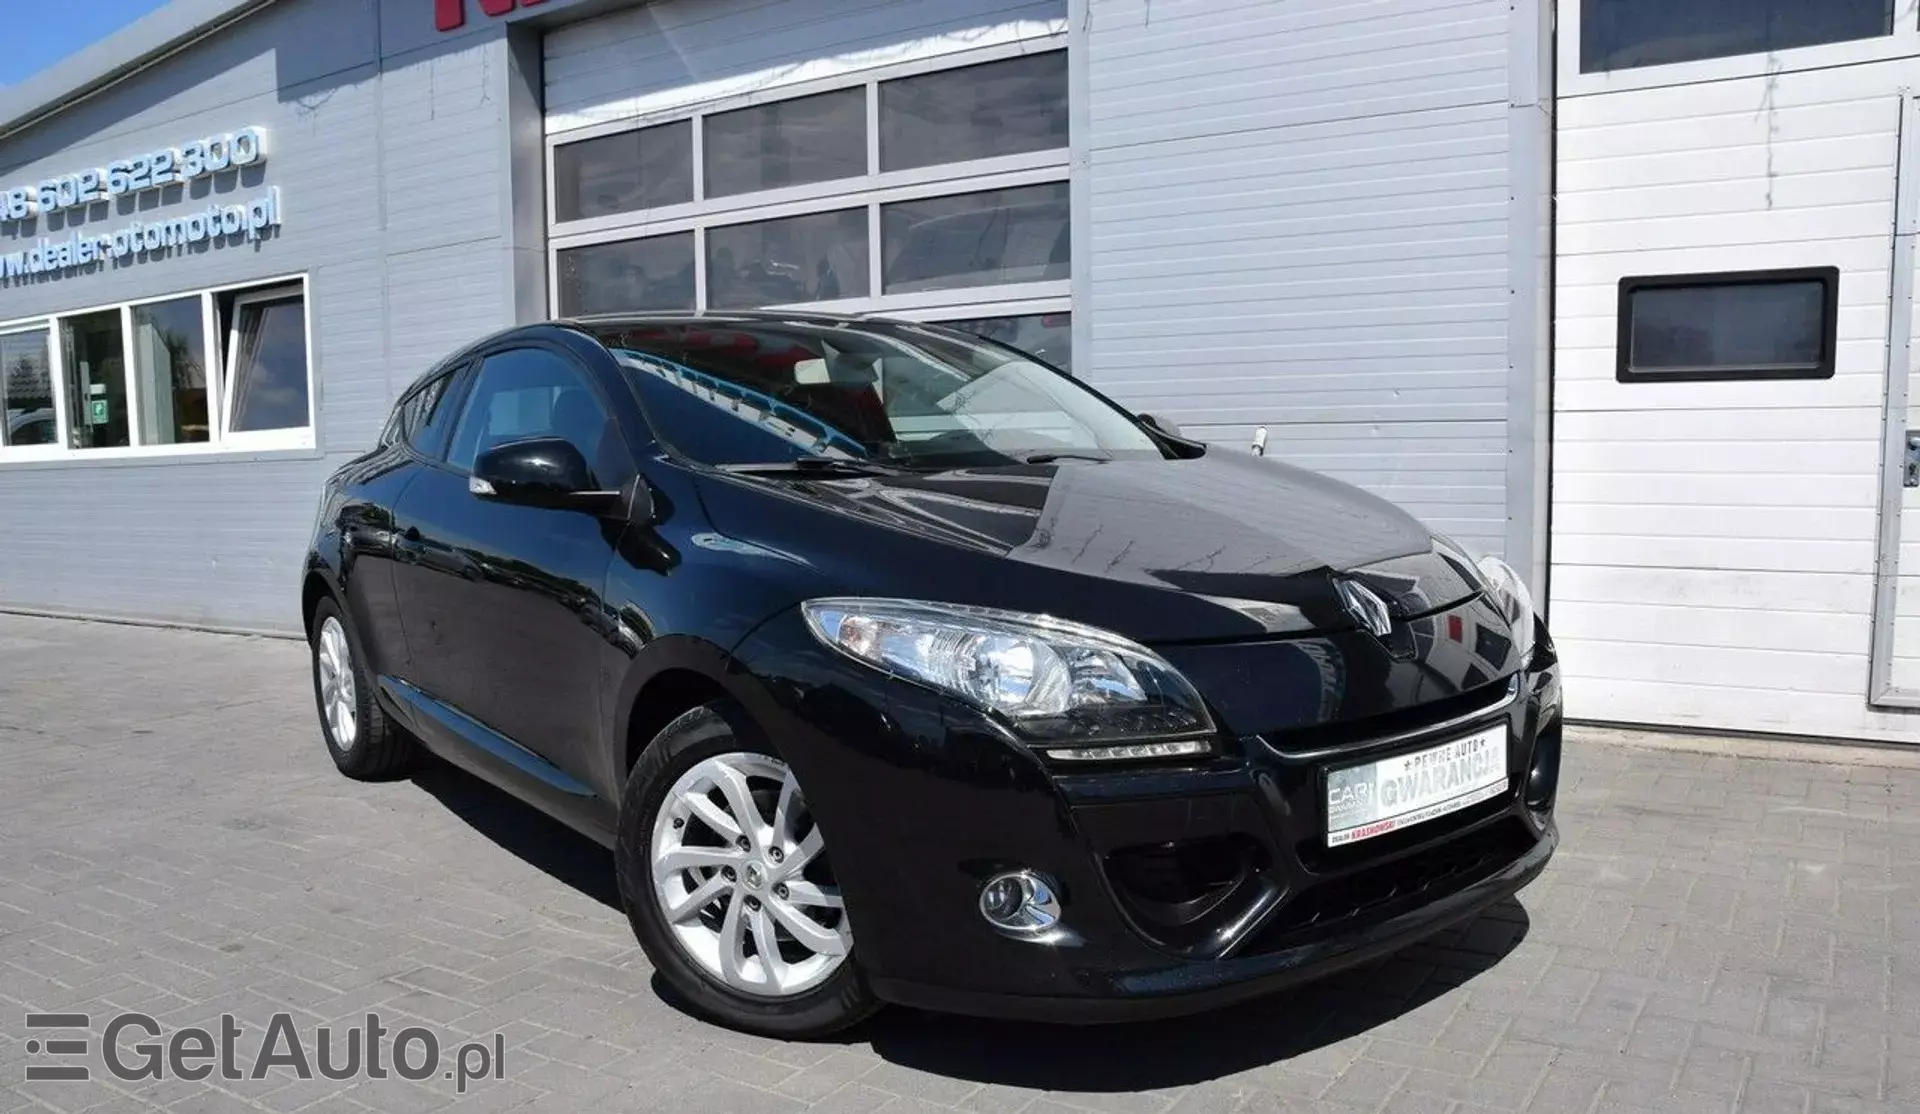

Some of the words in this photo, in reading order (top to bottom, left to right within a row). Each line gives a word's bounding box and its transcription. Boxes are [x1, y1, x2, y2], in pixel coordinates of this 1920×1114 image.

[38, 168, 108, 212] 602
[108, 148, 182, 195] 622
[182, 126, 268, 175] 300
[1455, 738, 1479, 758] AUTO
